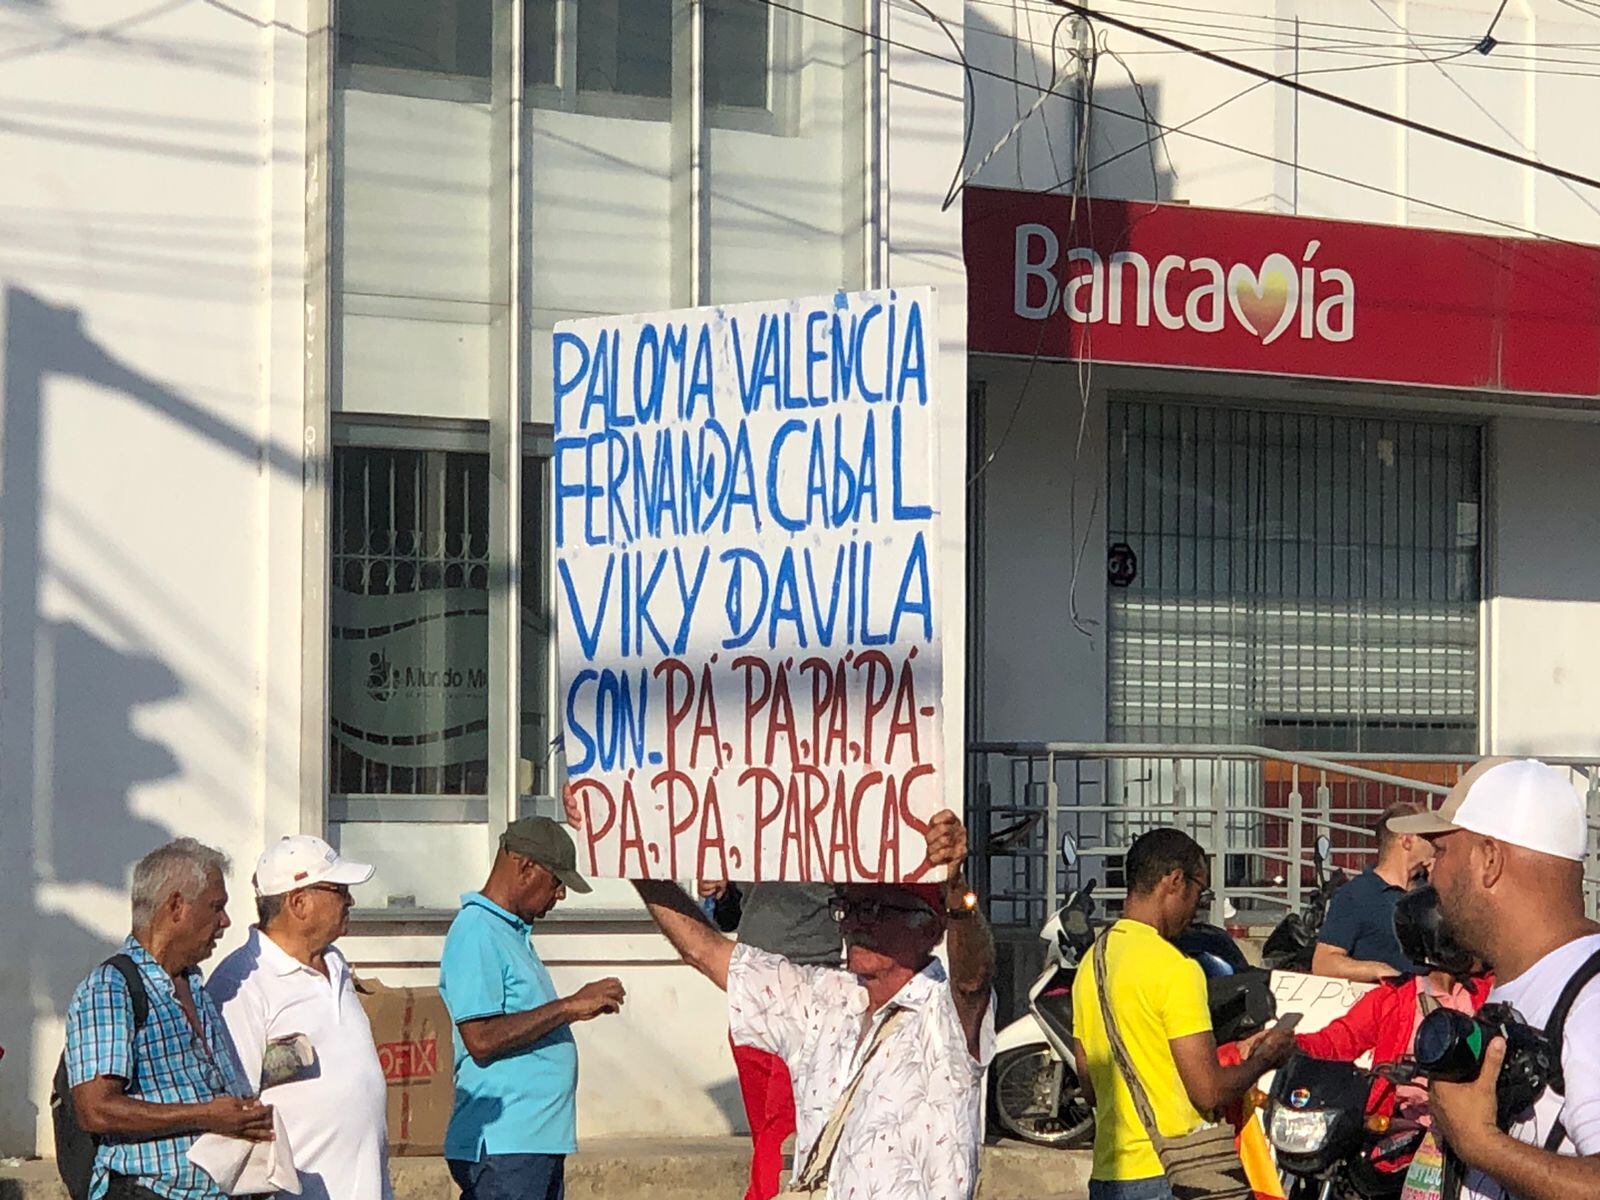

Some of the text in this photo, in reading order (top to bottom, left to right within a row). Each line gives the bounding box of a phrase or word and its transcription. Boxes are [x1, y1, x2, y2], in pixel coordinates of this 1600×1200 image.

[553, 322, 716, 434] PALOMA
[554, 417, 762, 548] FERNANDA
[405, 666, 463, 688] Mundo
[738, 763, 937, 884] PARACAS
[1274, 975, 1309, 1002] EL
